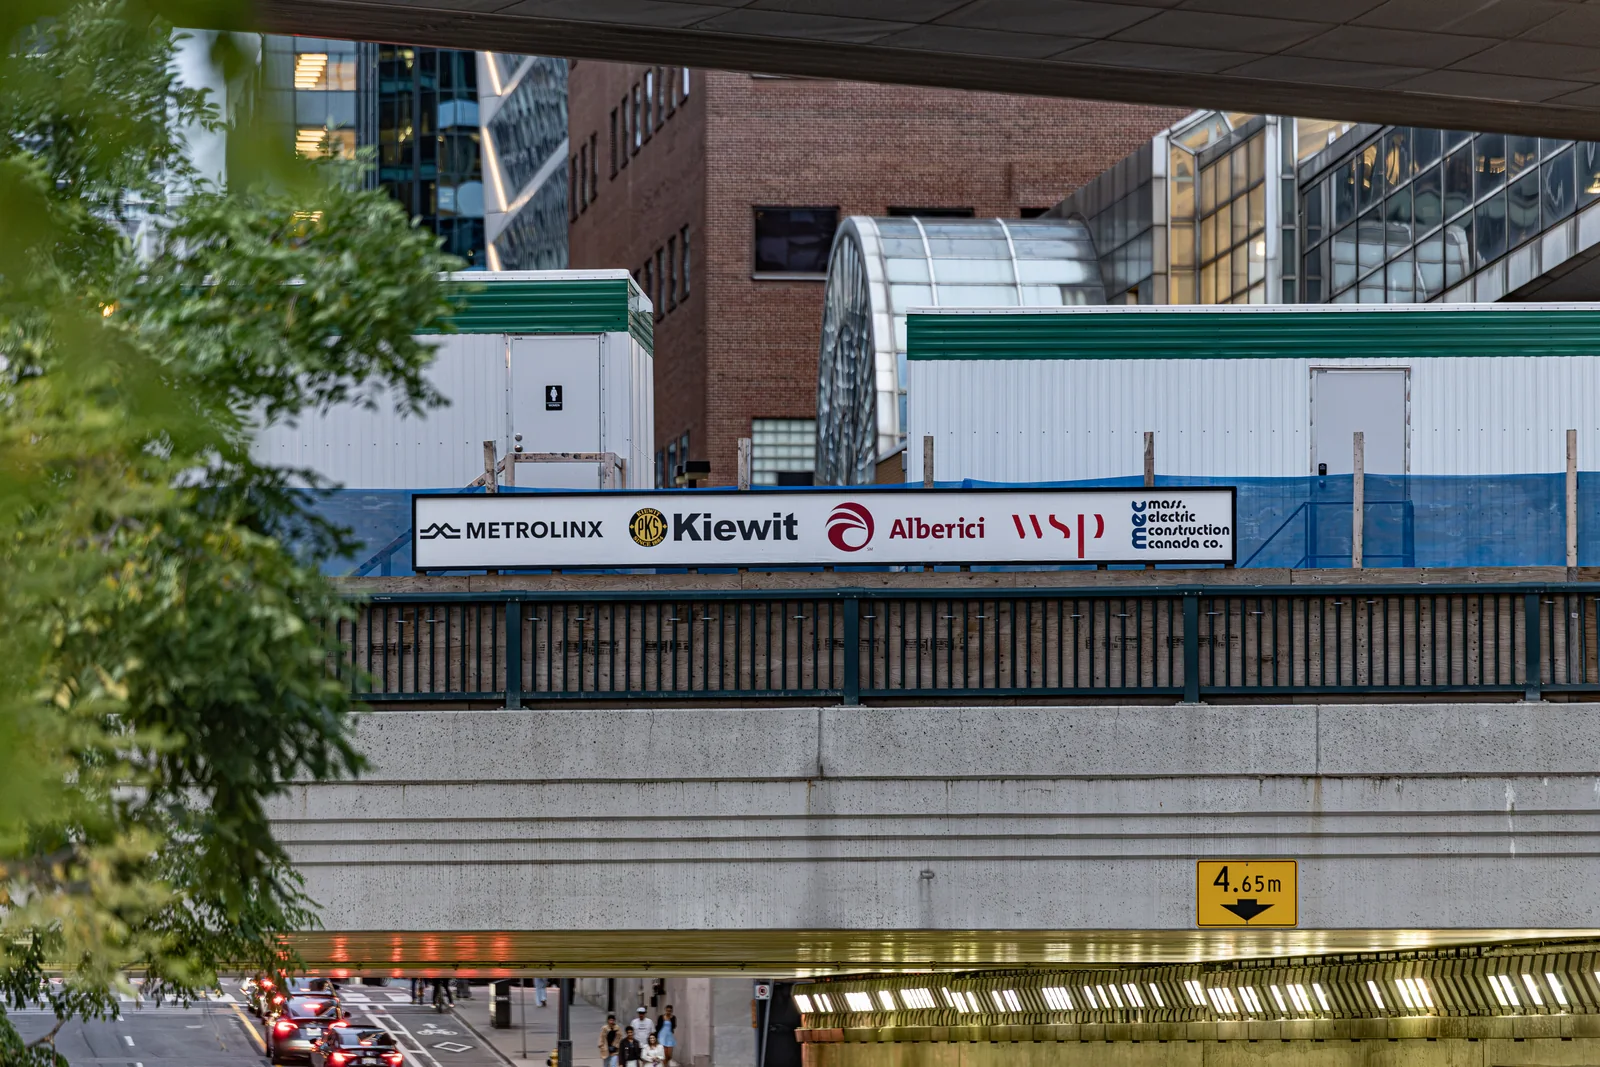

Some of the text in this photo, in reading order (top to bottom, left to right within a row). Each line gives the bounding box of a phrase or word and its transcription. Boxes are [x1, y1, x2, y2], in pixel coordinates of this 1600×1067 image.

[1148, 500, 1187, 510] mass.
[1148, 510, 1196, 523] electric
[466, 520, 604, 540] METROLINX
[637, 515, 659, 540] PKS
[673, 512, 799, 542] Kiewit
[889, 516, 985, 540] Alberici
[1012, 513, 1105, 559] wsp
[1131, 500, 1147, 549] mec
[1148, 523, 1230, 536] construction
[1148, 537, 1223, 549] canada co.
[1213, 865, 1281, 893] 4.65m
